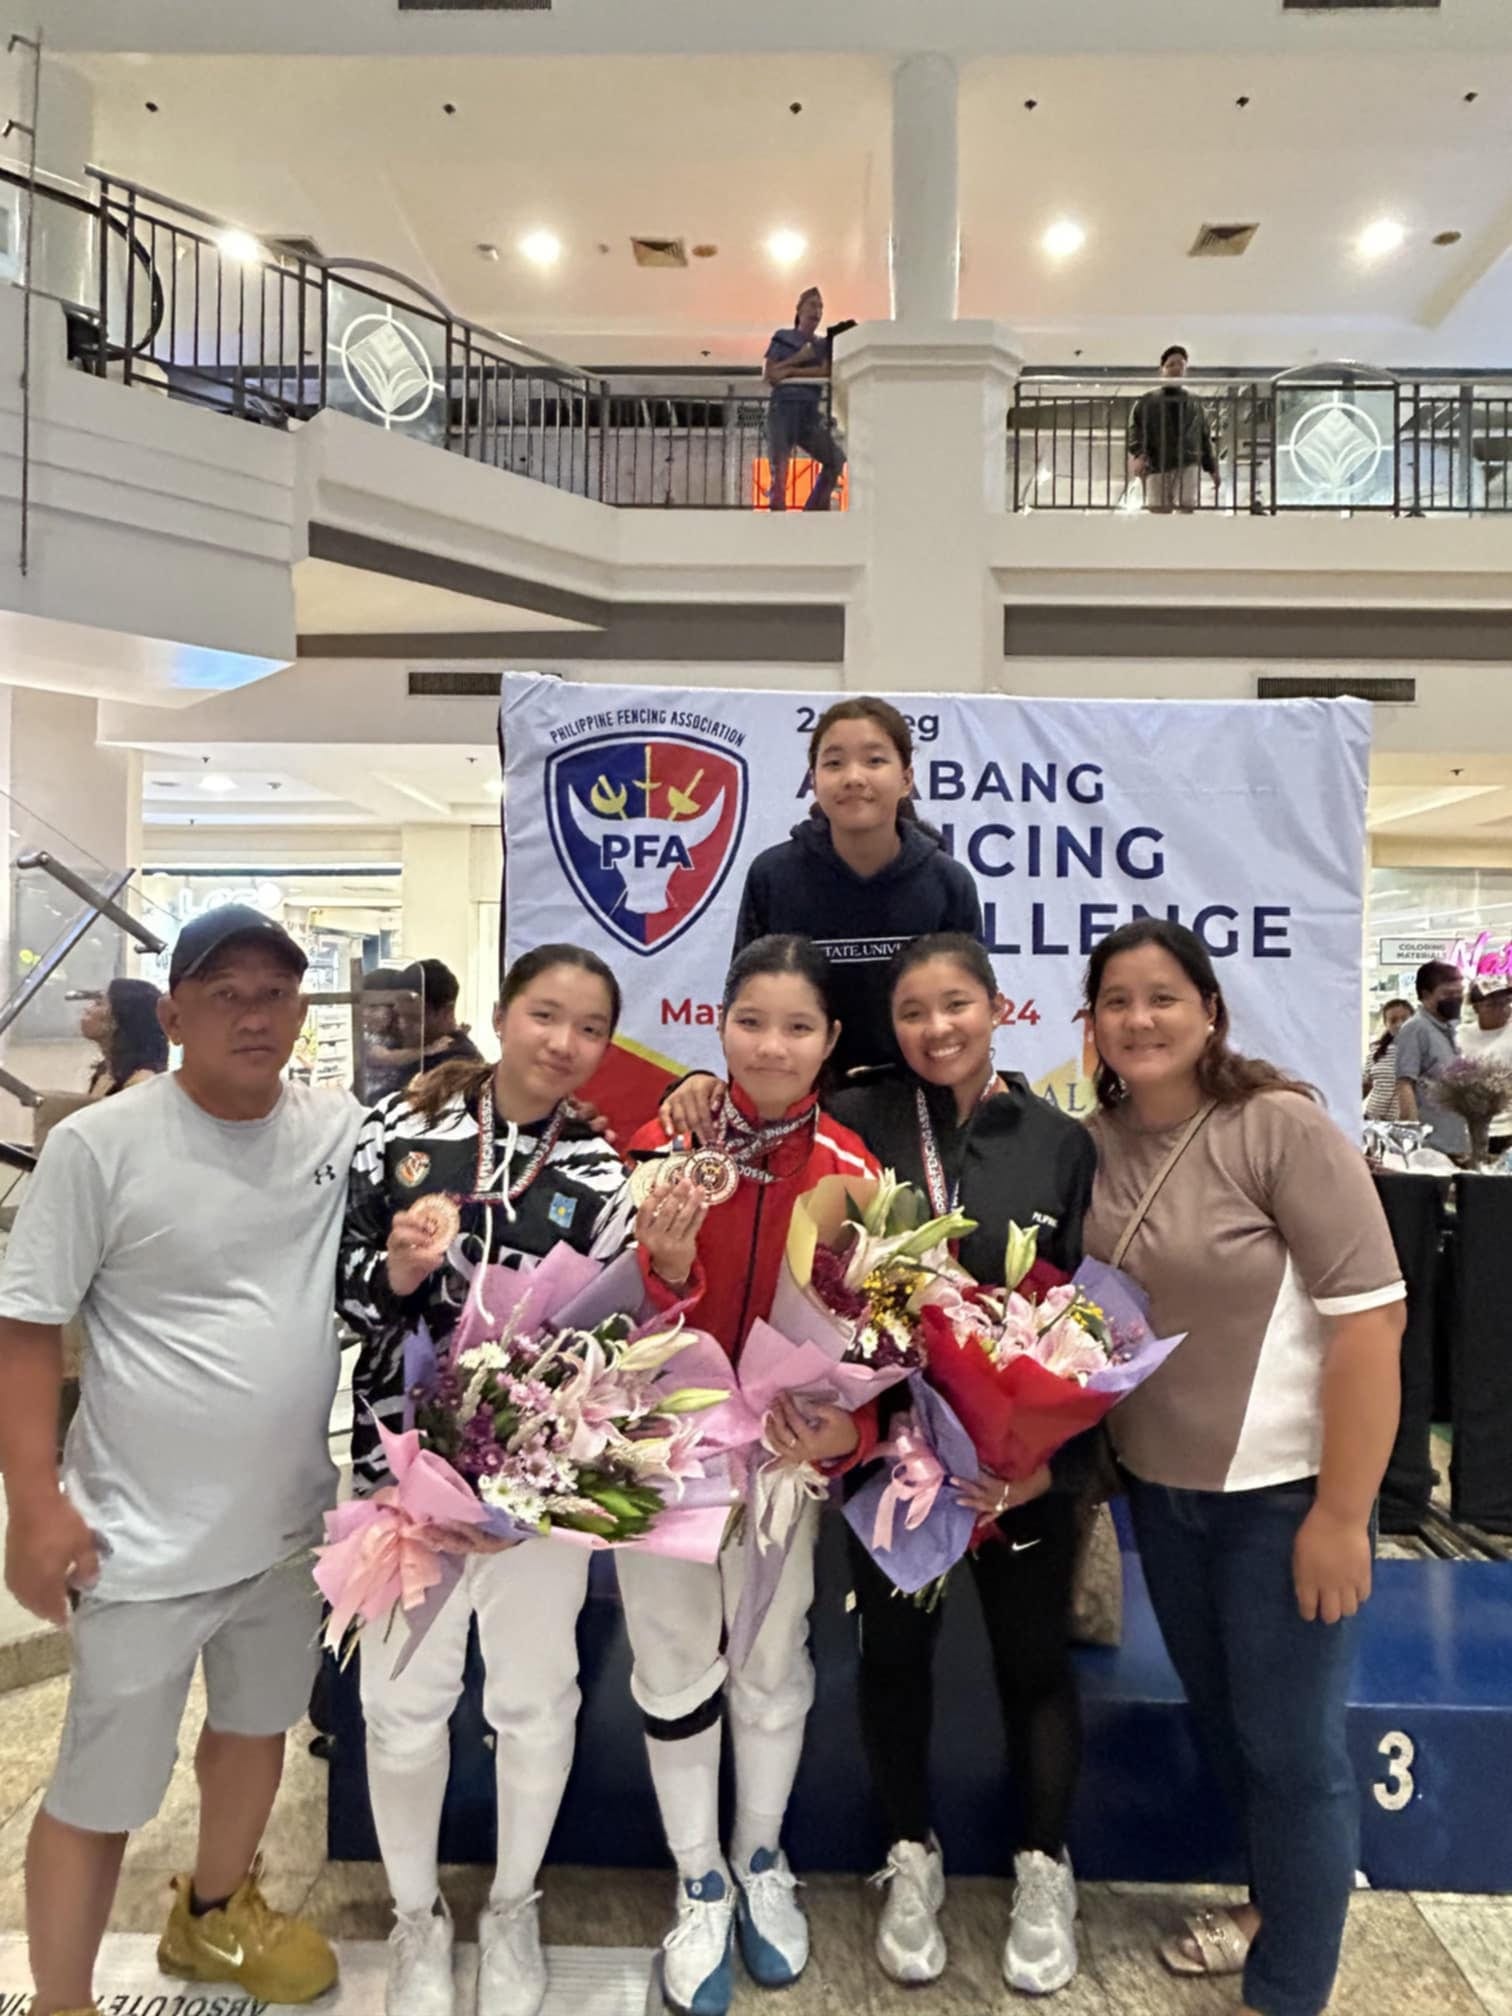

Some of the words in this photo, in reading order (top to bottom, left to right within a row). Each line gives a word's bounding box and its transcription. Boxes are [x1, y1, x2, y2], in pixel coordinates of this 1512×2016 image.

[550, 711, 613, 744] PHILIPPINE
[617, 708, 667, 725] FENCING
[670, 711, 746, 747] ASSOCIATION
[602, 834, 694, 869] PFA
[661, 998, 724, 1031] Ma
[1373, 1730, 1414, 1811] 3
